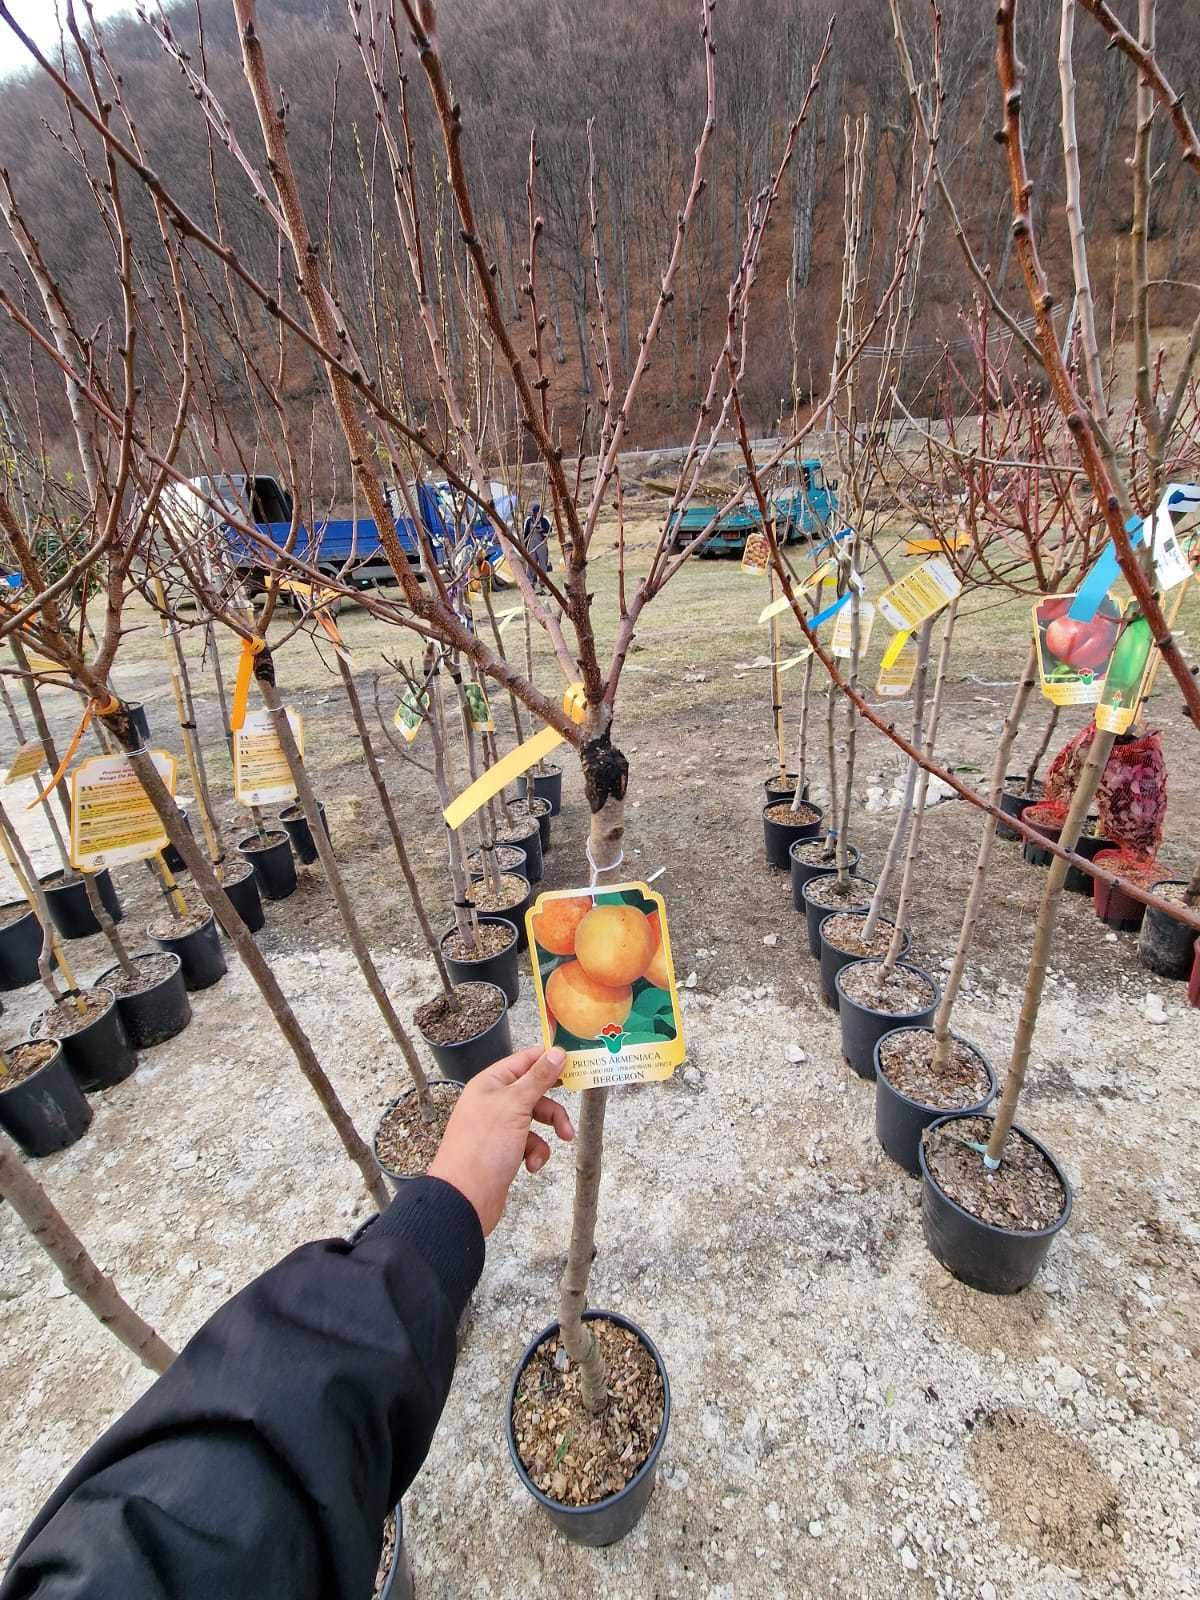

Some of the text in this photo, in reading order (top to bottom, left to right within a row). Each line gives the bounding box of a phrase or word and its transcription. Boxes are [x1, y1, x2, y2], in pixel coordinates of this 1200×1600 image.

[572, 1057, 607, 1069] PRUNUS
[608, 1052, 661, 1065] ARMENIACA
[593, 1071, 645, 1085] BERGERON
